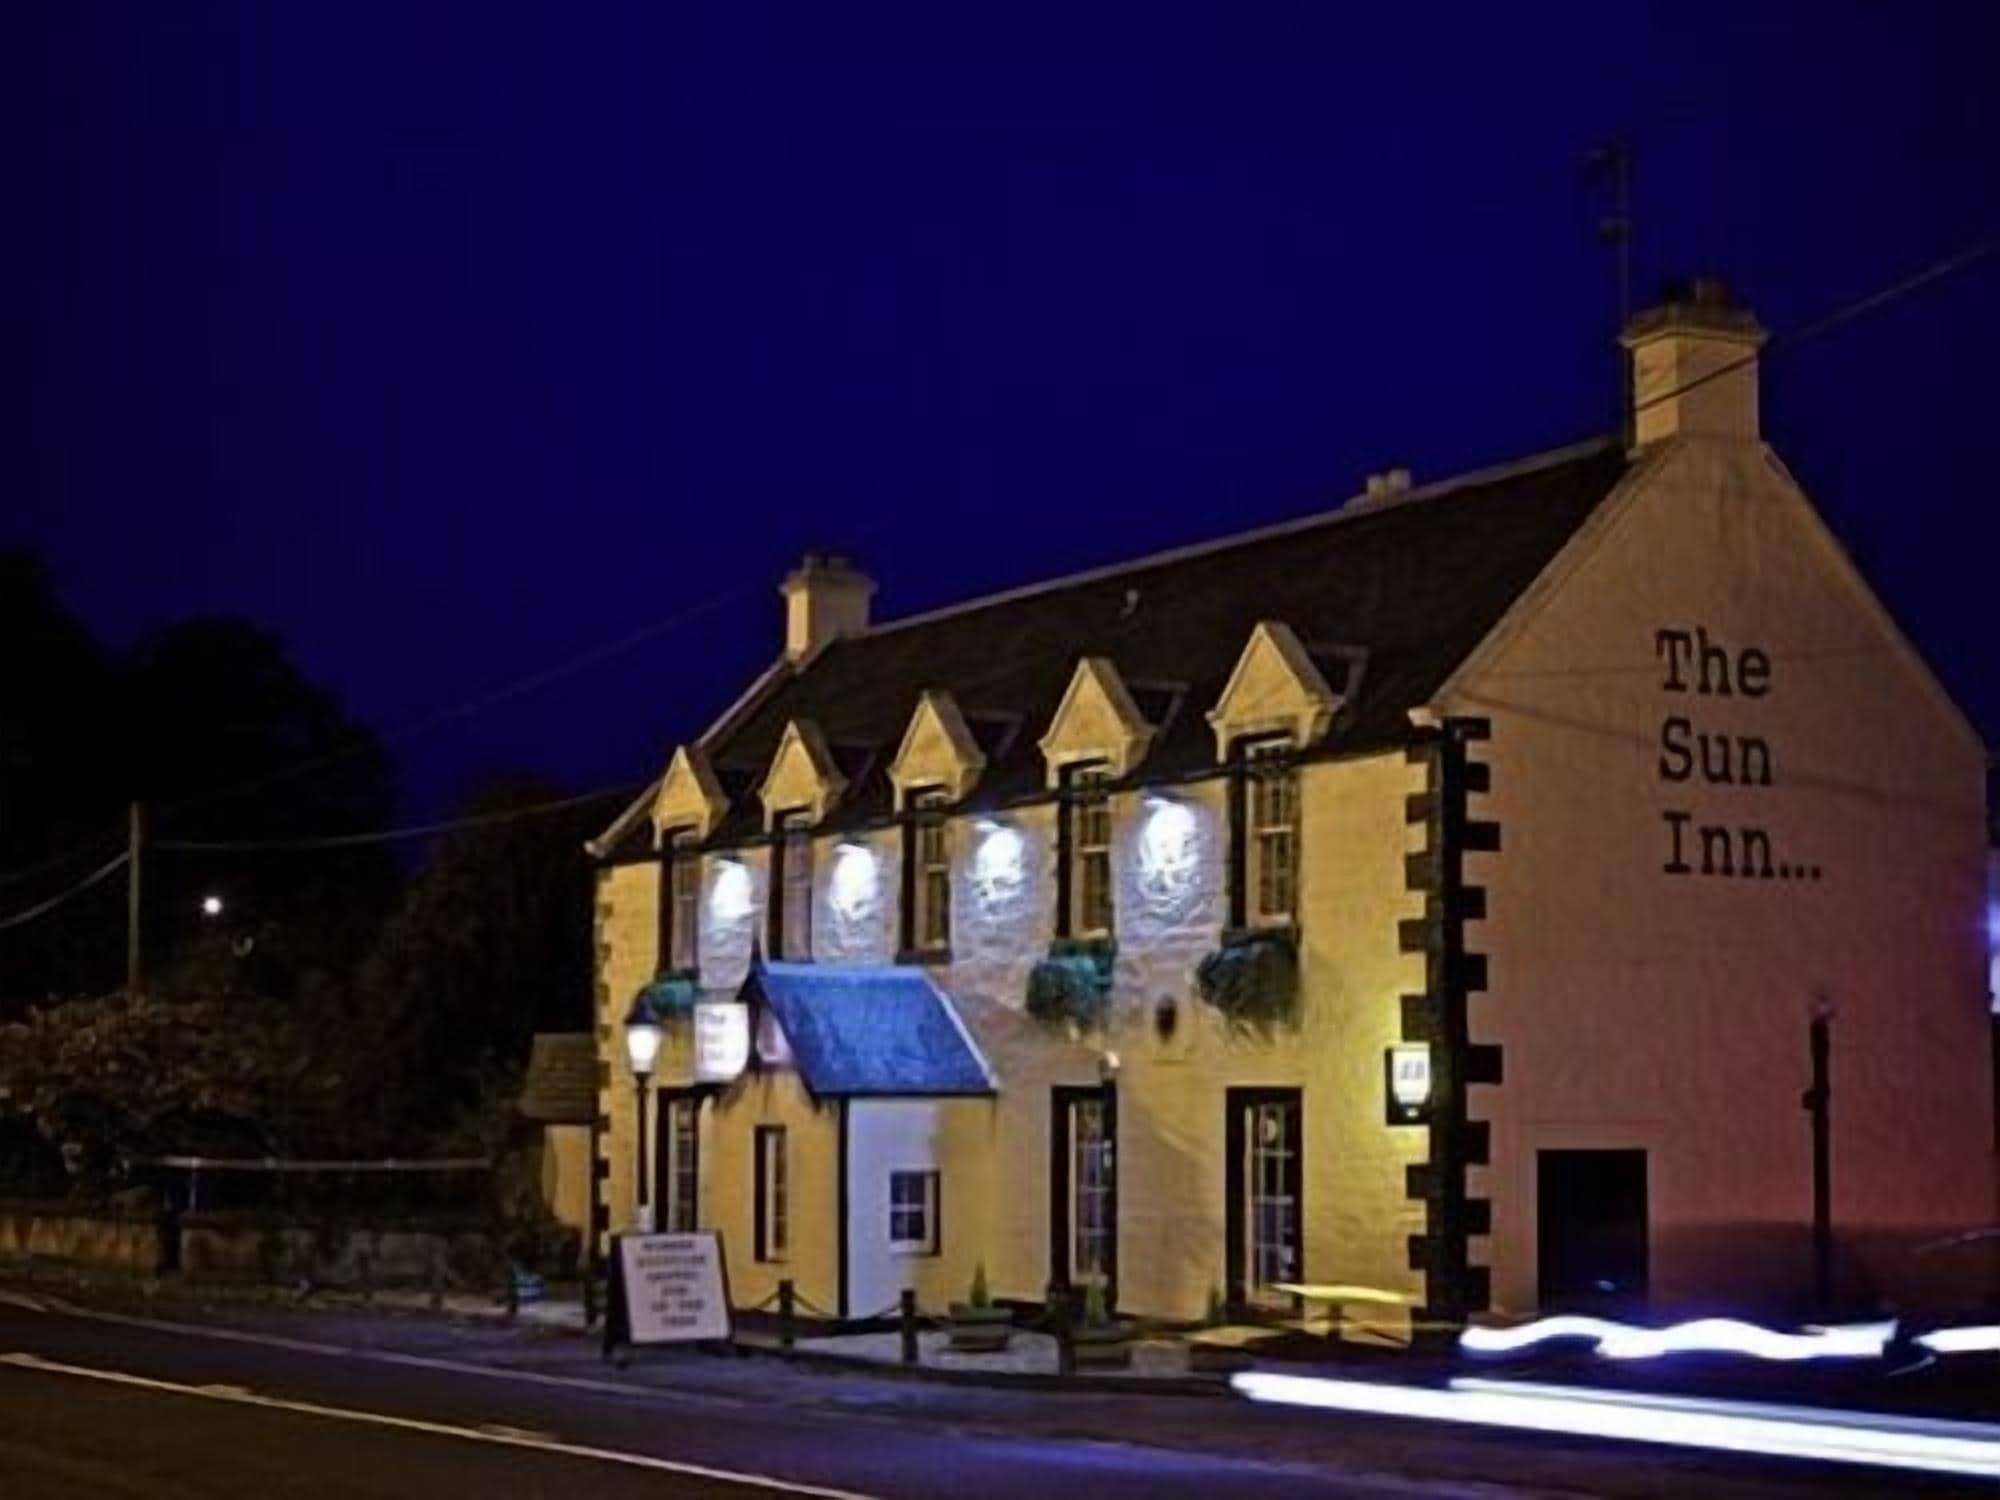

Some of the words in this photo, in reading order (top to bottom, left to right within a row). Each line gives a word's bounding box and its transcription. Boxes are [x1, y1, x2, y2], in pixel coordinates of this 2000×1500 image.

[1656, 626, 1772, 697] The
[1660, 716, 1772, 786] Sun
[1663, 810, 1822, 880] Inn...
